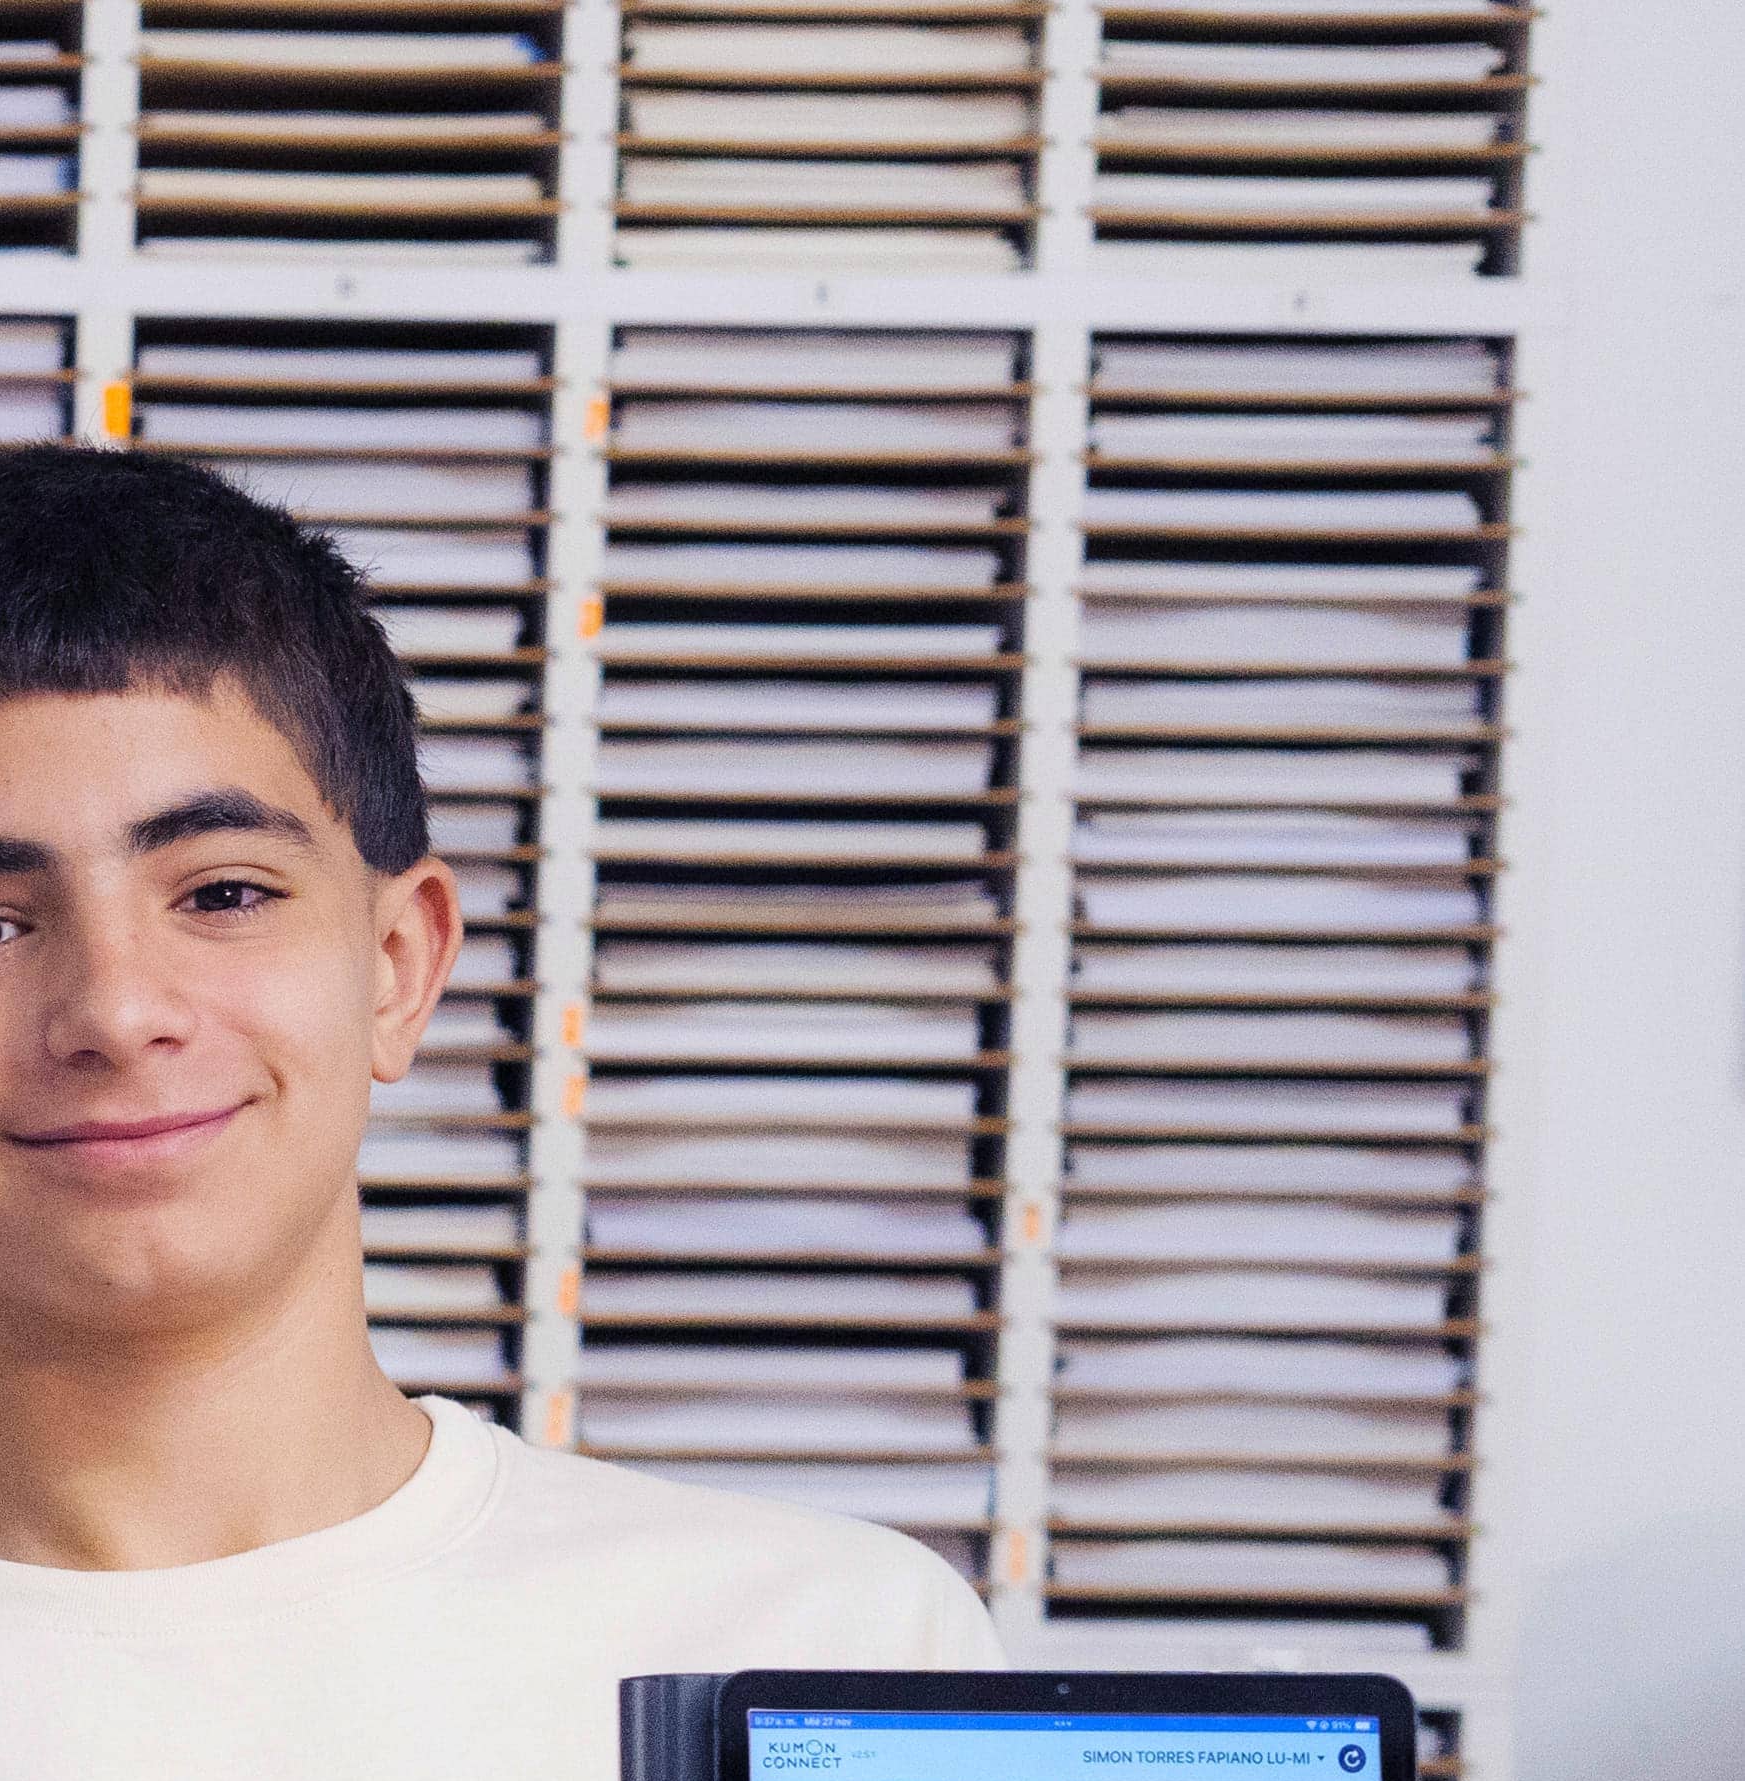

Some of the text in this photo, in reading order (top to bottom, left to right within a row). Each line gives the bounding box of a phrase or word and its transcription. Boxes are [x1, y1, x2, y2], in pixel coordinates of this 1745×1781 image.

[768, 1739, 836, 1756] KUMON
[762, 1756, 842, 1769] CONNECT
[1082, 1751, 1310, 1765] SIMON TORRES FAPIANO LU-MI
